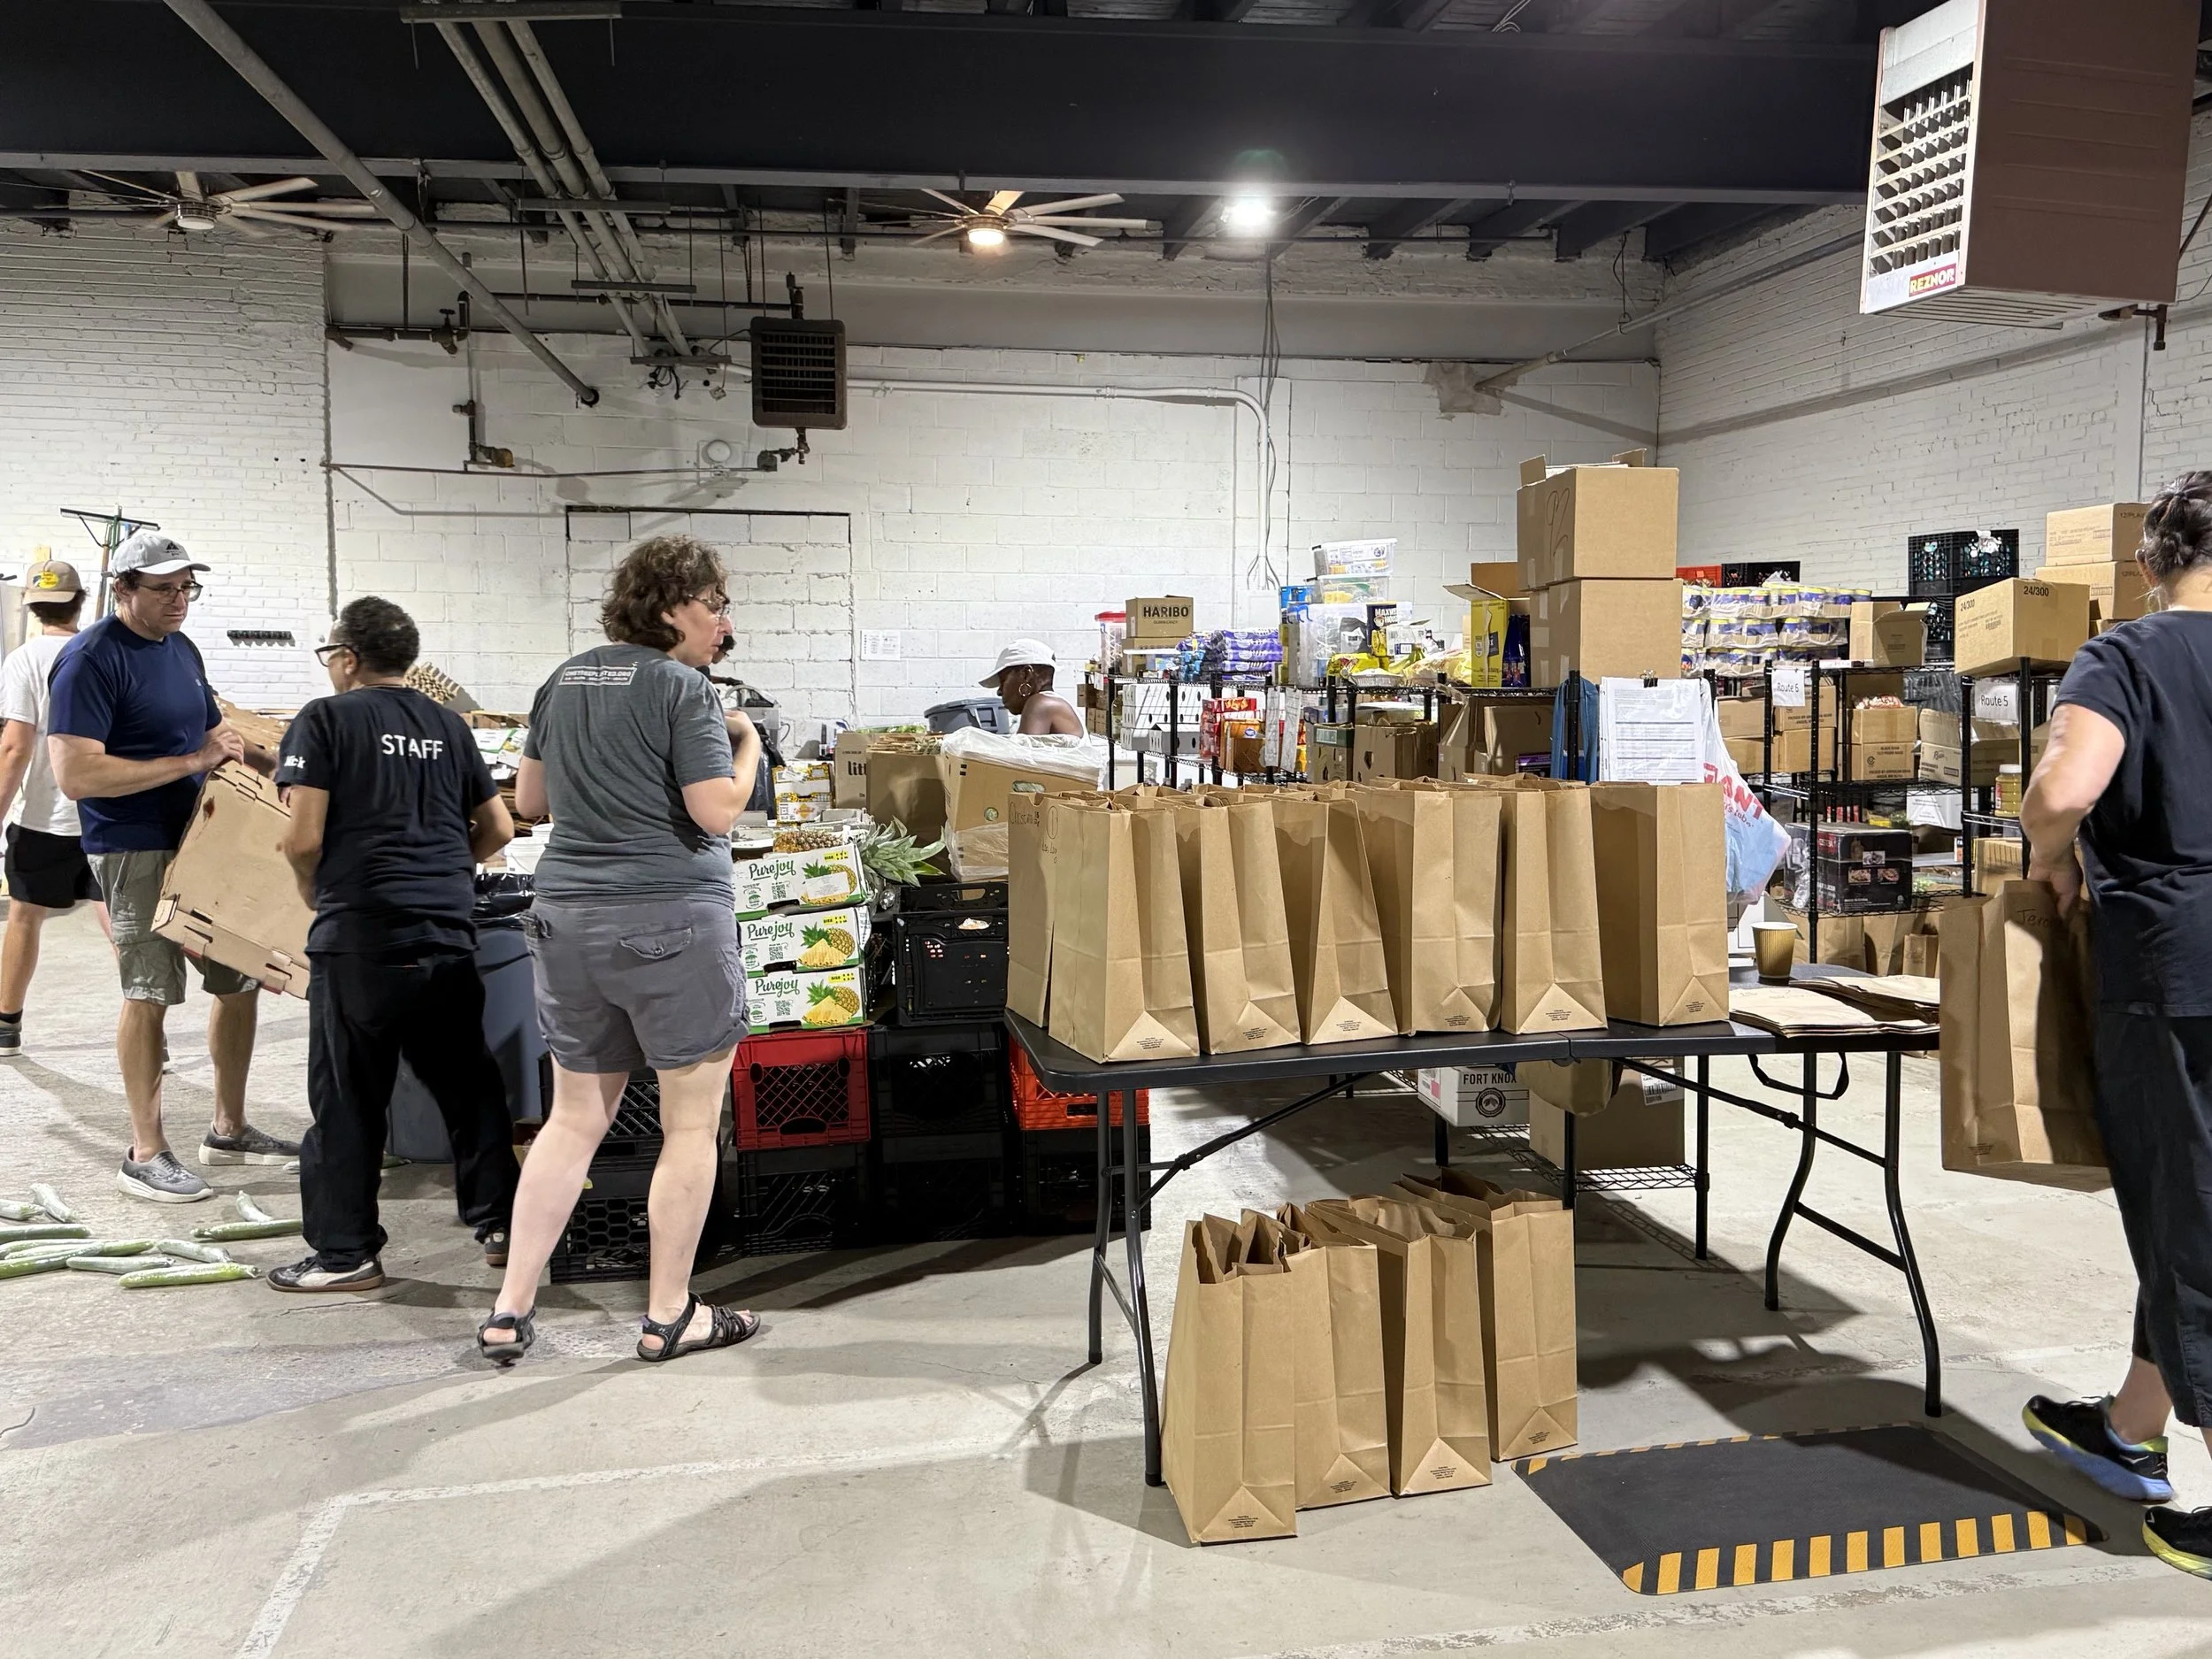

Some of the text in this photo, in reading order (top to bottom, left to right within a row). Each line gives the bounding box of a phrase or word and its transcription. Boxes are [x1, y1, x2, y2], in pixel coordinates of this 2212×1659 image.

[1910, 268, 1955, 294] REZNOR
[2024, 586, 2049, 596] 24/300
[1143, 606, 1189, 618] HARIBO
[1778, 682, 1794, 693] Route
[1981, 695, 2008, 706] Route 5
[380, 733, 443, 760] STAFF
[749, 859, 796, 880] Purejoy
[747, 921, 795, 941] Purejoy
[755, 978, 800, 997] Purejoy
[1463, 1072, 1517, 1085] FORT KNOX
